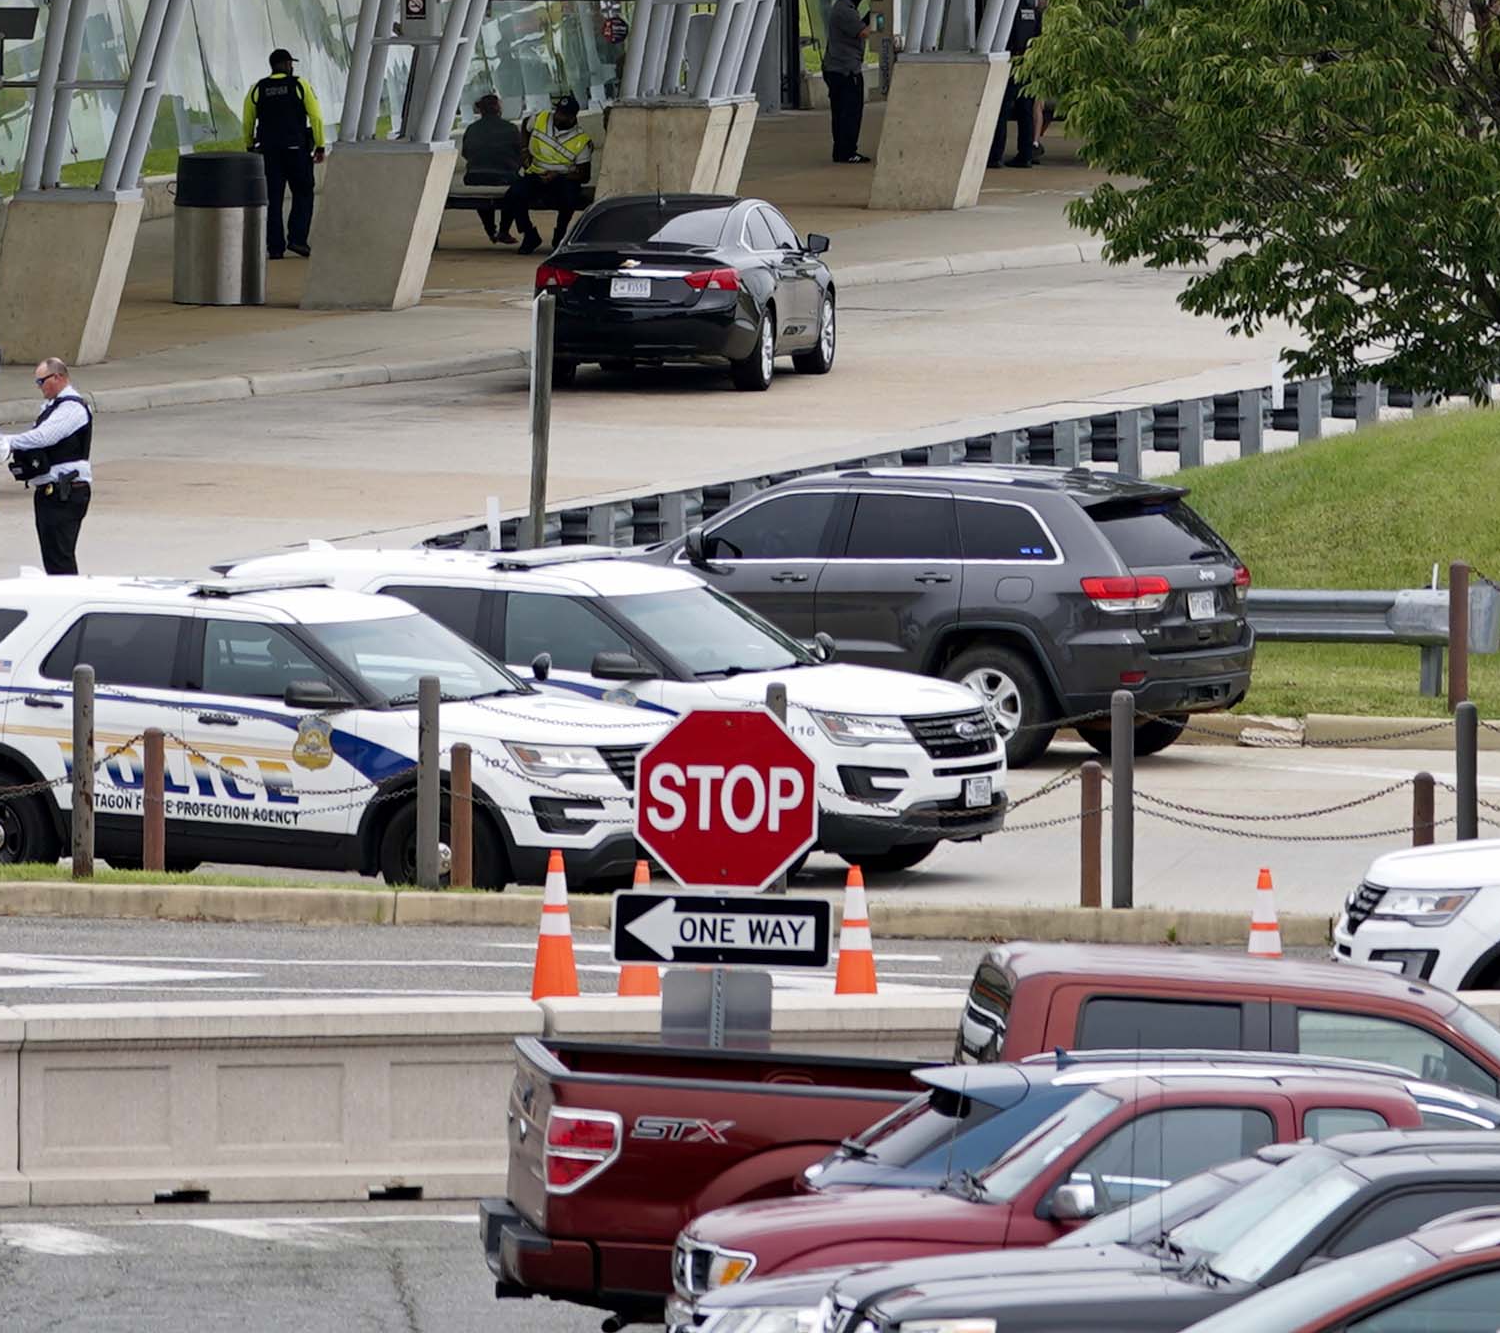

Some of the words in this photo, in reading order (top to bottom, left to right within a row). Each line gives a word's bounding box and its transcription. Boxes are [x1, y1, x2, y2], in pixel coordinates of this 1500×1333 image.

[646, 762, 805, 833] STOP
[252, 807, 300, 825] AGENCY
[679, 917, 735, 943] ONE
[748, 919, 806, 946] WAY
[630, 1115, 737, 1144] STX
